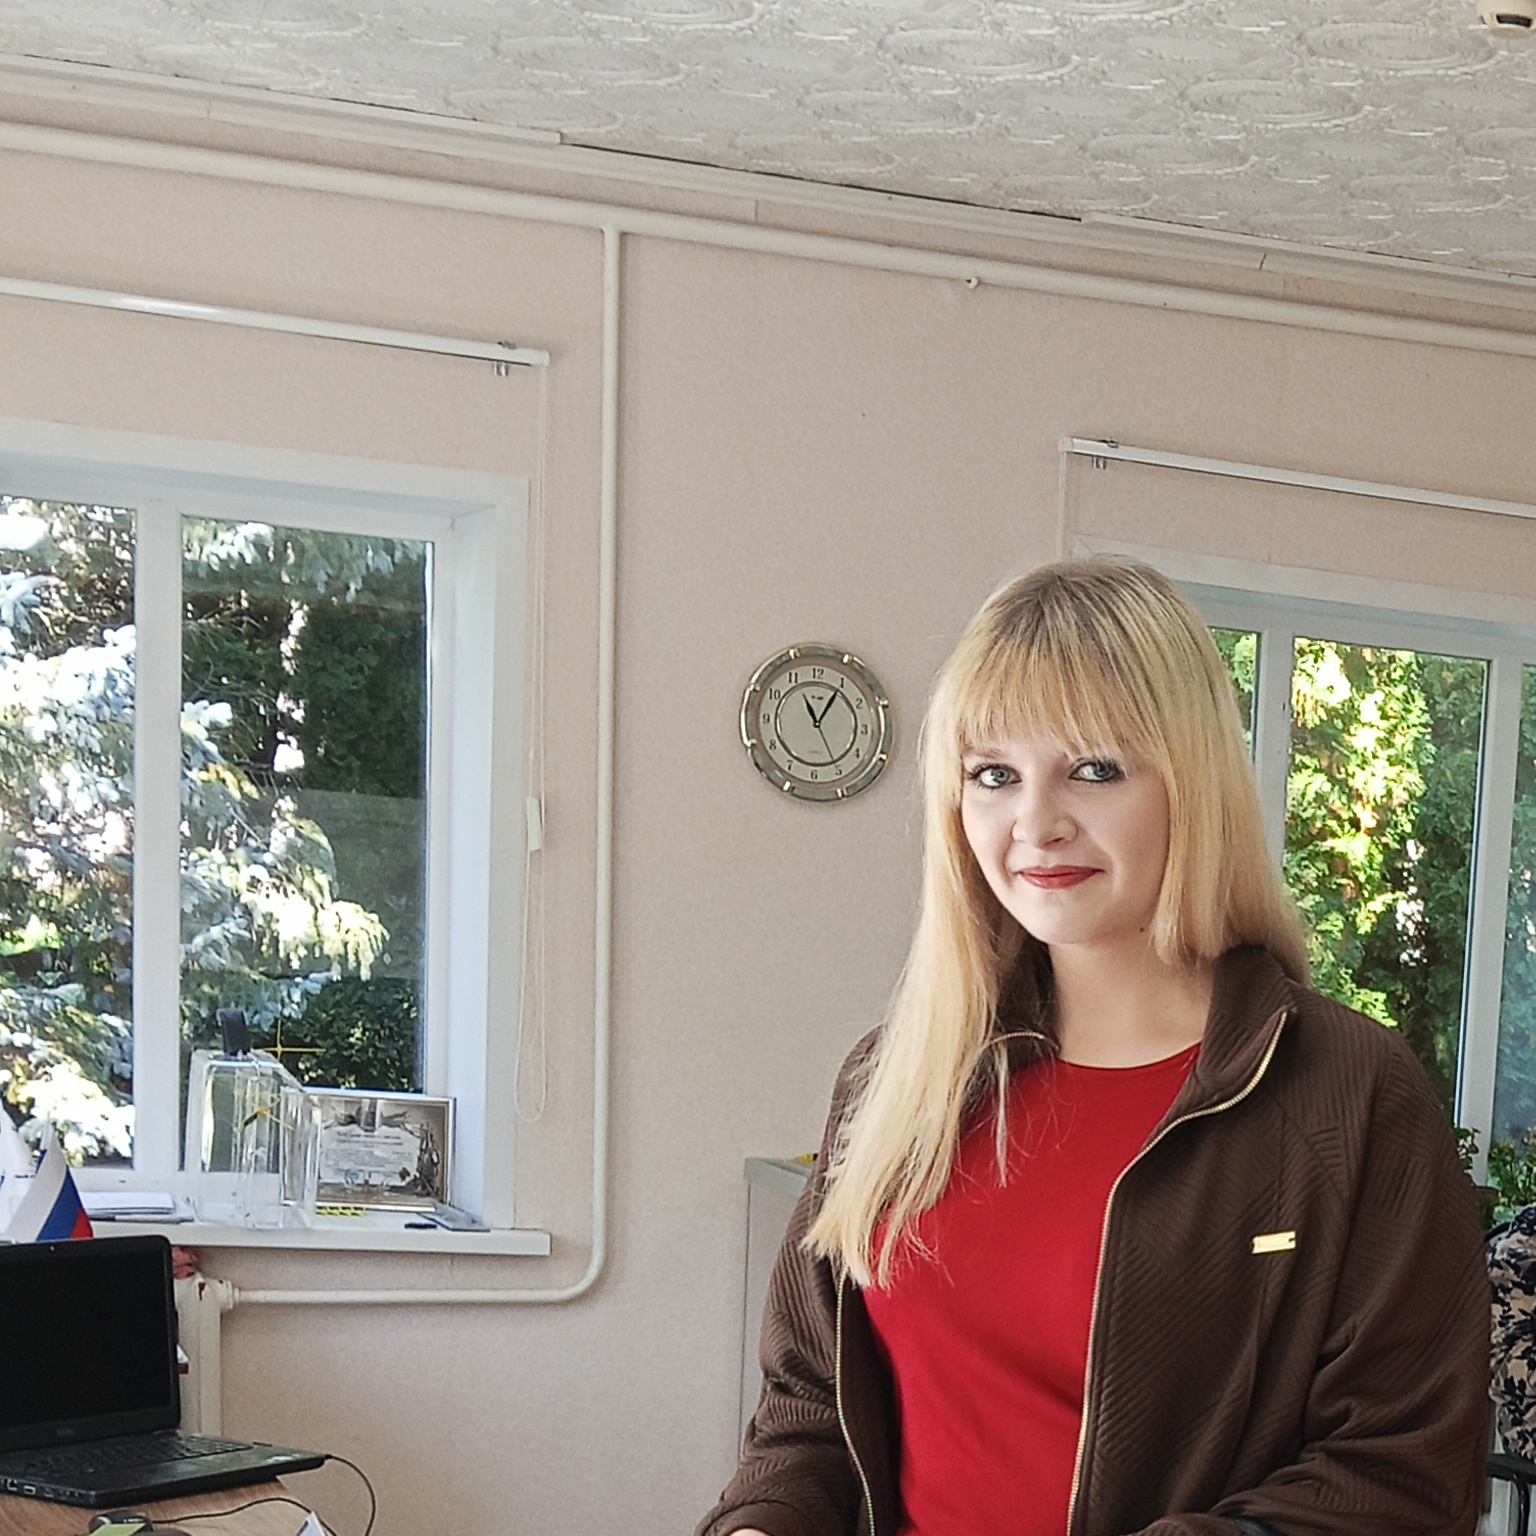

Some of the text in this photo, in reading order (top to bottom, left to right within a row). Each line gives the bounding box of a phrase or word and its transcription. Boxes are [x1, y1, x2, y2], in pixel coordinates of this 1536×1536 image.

[788, 672, 799, 684] 11
[812, 668, 824, 679] 12
[839, 677, 845, 689] 1
[768, 688, 781, 700] 10
[855, 698, 863, 709] 2
[762, 713, 771, 724] 9
[860, 724, 868, 735] 3
[769, 740, 777, 750] 8
[855, 748, 860, 759] 4
[786, 760, 794, 771] 7
[810, 770, 818, 780] 6
